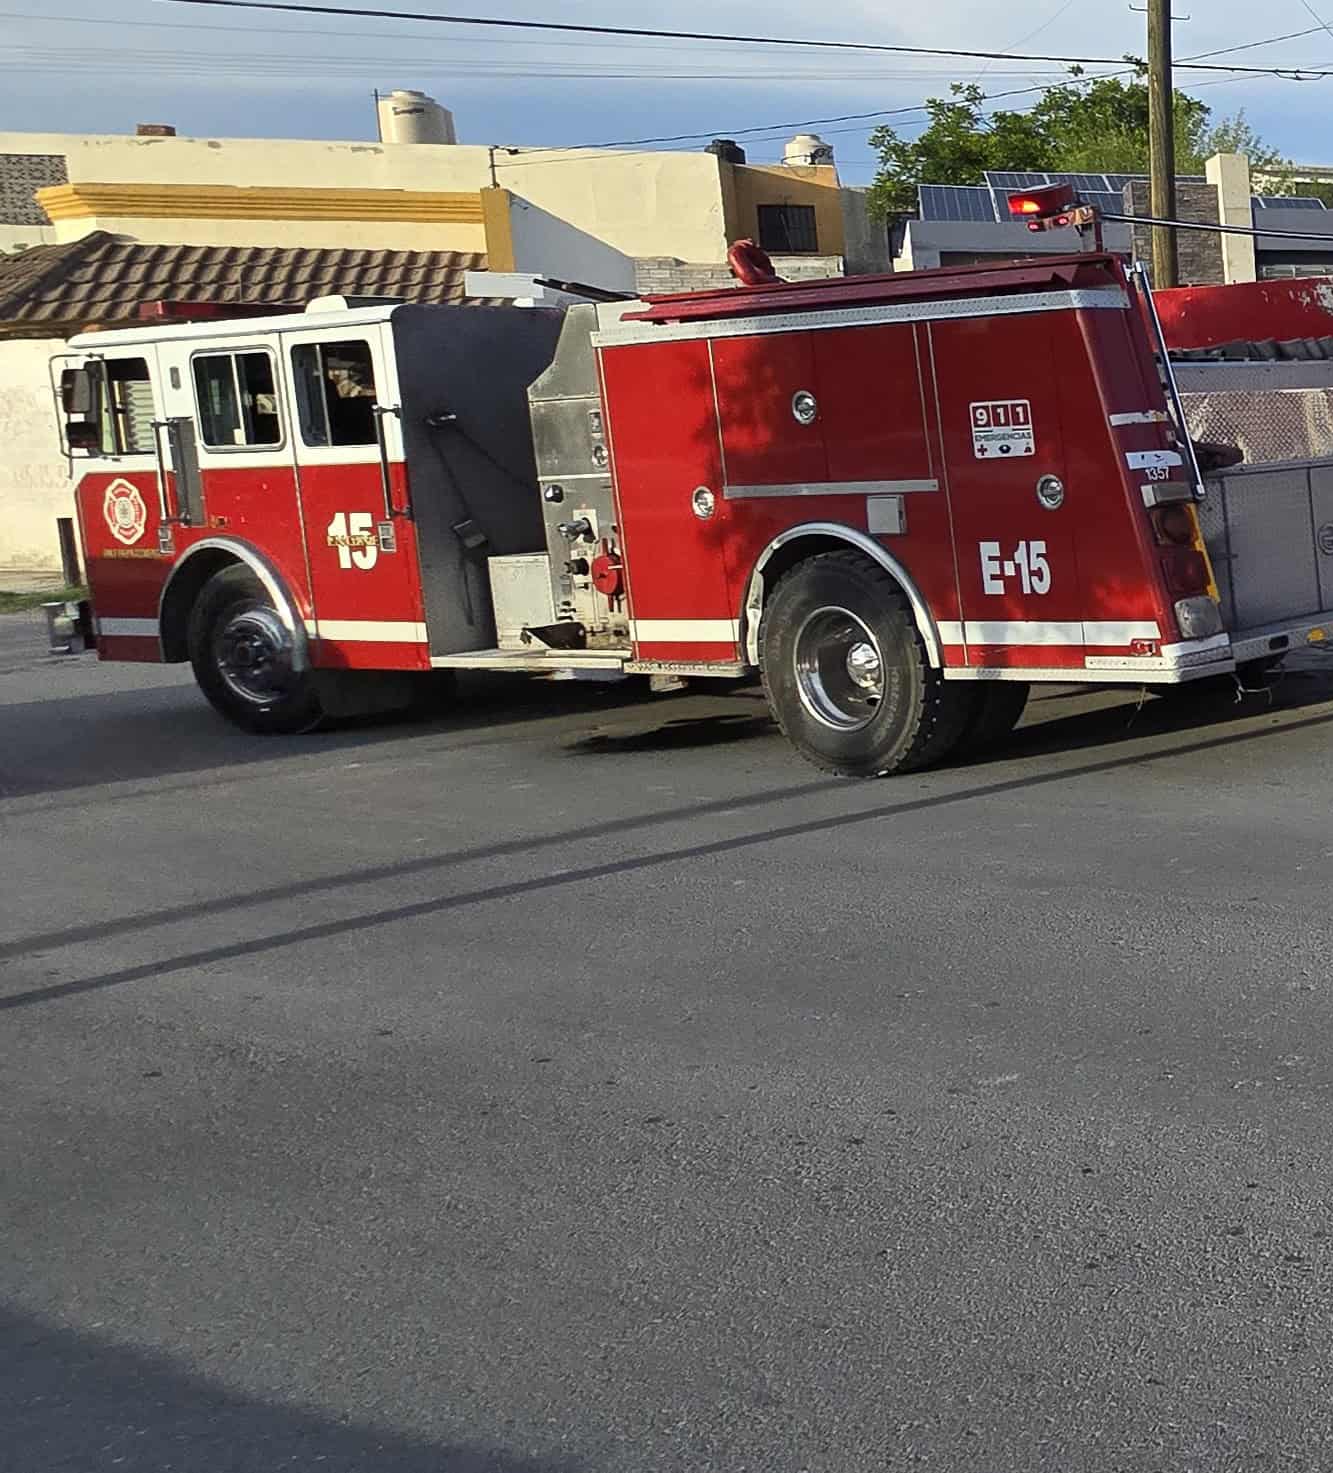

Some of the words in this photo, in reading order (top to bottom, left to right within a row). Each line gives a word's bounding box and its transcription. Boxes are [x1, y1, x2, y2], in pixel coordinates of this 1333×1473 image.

[975, 408, 1025, 425] 911
[1145, 466, 1169, 480] 1357
[327, 512, 378, 570] 15
[980, 541, 1051, 595] E-15
